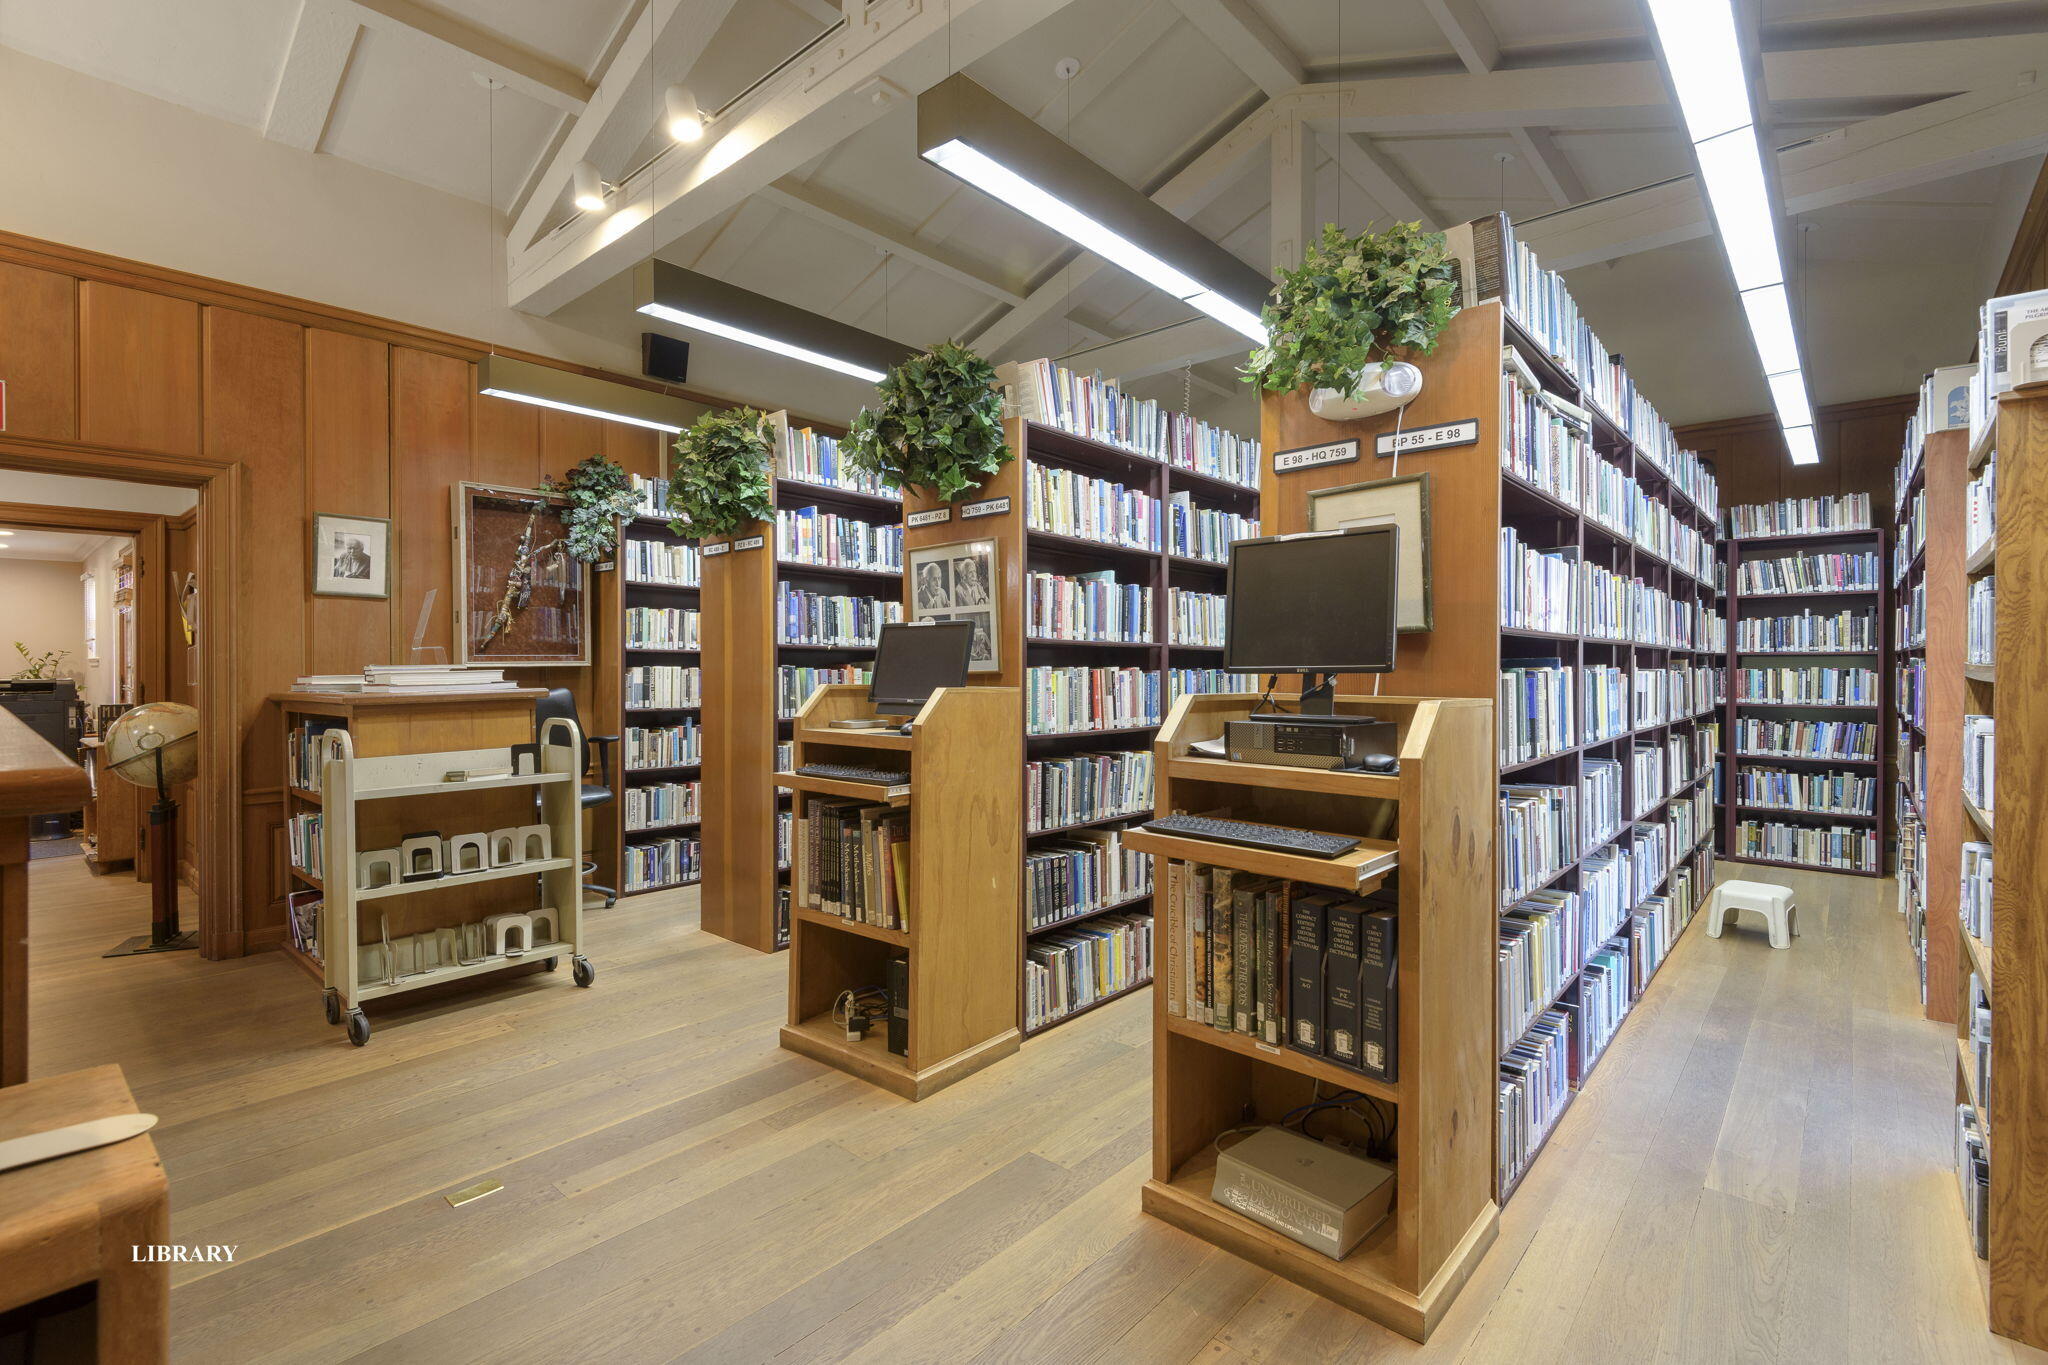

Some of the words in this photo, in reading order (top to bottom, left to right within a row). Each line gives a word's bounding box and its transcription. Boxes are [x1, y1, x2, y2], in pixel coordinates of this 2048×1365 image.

[1392, 436, 1408, 449] BP
[1411, 434, 1425, 446] 55
[1435, 430, 1444, 441] E
[1446, 427, 1461, 439] 98
[1283, 457, 1290, 466] E
[1292, 454, 1303, 465] 98
[1311, 450, 1327, 462] HQ
[1329, 447, 1347, 459] 759
[1168, 874, 1178, 893] The
[1168, 893, 1179, 934] Crucible
[1169, 934, 1180, 946] of
[1329, 948, 1358, 959] DICTIONARY
[1251, 1179, 1332, 1225] UNABRIDGED
